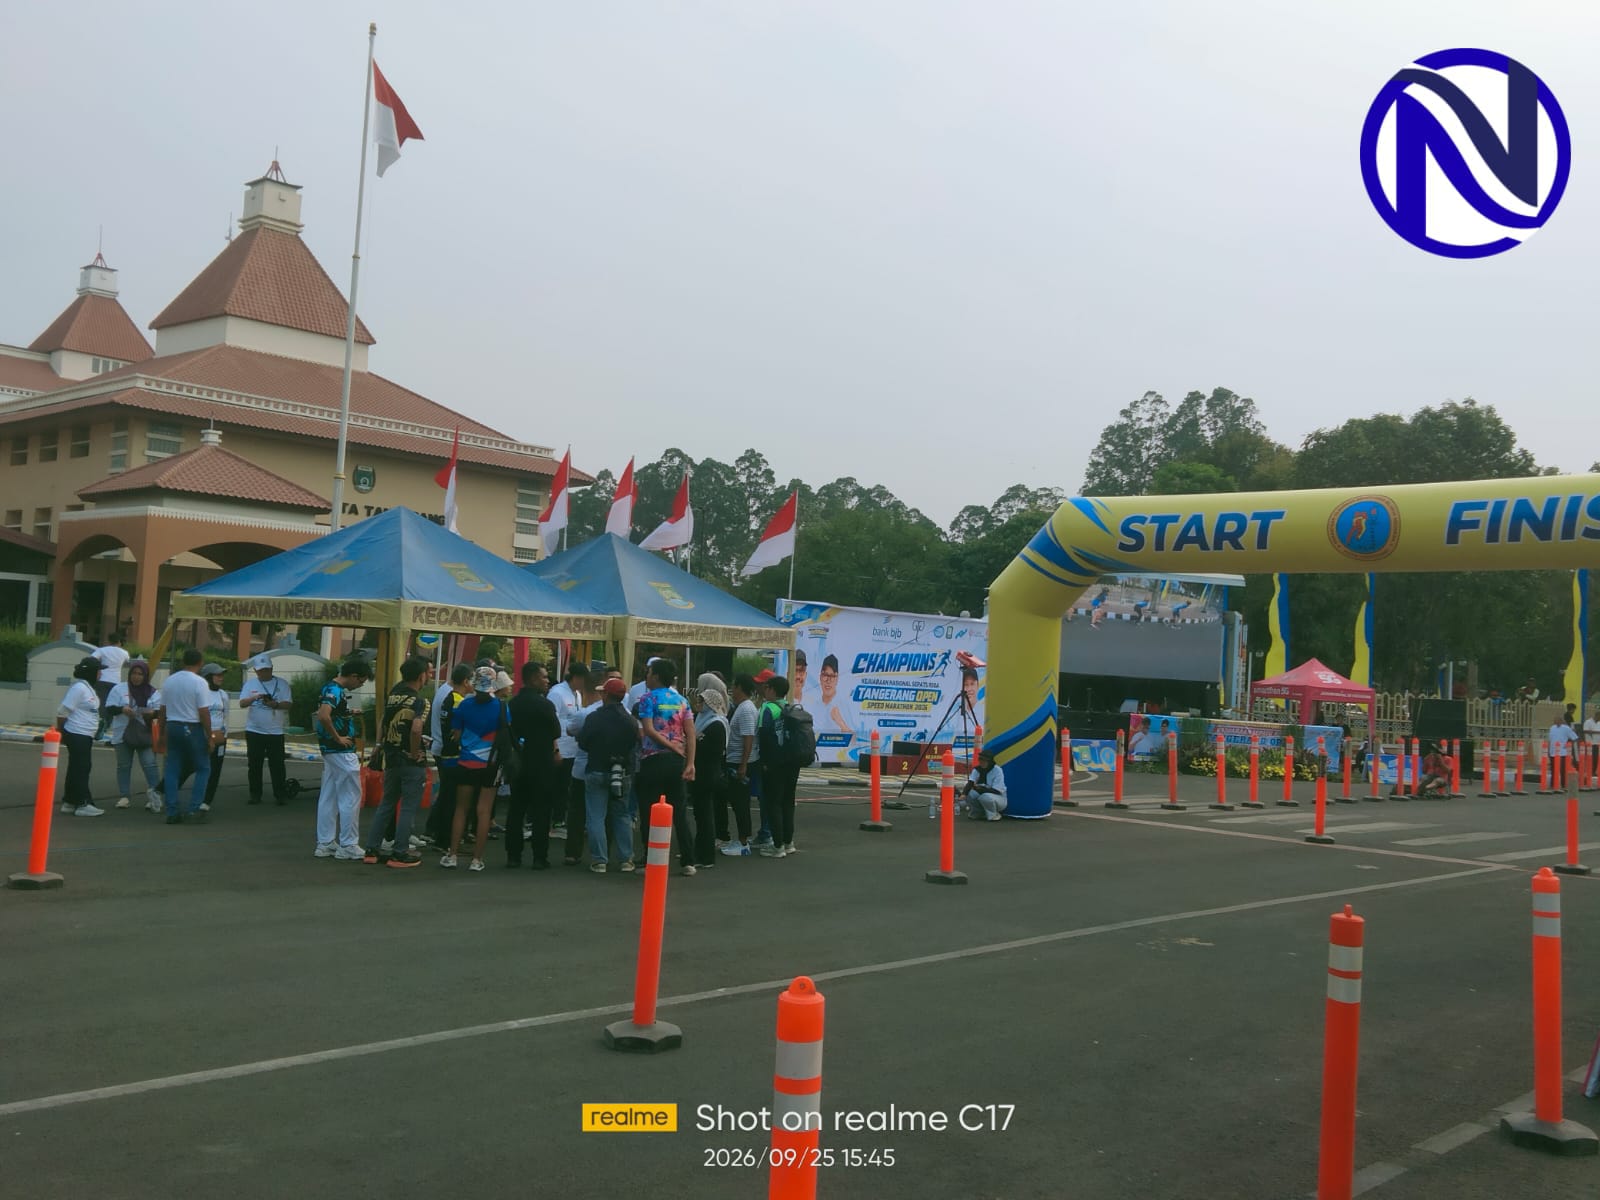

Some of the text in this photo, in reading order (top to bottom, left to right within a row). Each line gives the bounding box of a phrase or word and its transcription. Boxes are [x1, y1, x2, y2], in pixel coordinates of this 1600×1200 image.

[1118, 510, 1286, 552] START
[205, 600, 361, 621] KECAMATAN NEGLASARI
[412, 606, 606, 635] KECAMATAN NEGLASARI
[636, 620, 718, 641] KECAMATAN
[872, 627, 902, 640] bank bjb
[852, 652, 938, 674] CHAMPIONS
[858, 688, 937, 701] TANGERANG OPEN
[933, 746, 938, 755] 1
[902, 761, 908, 770] 2
